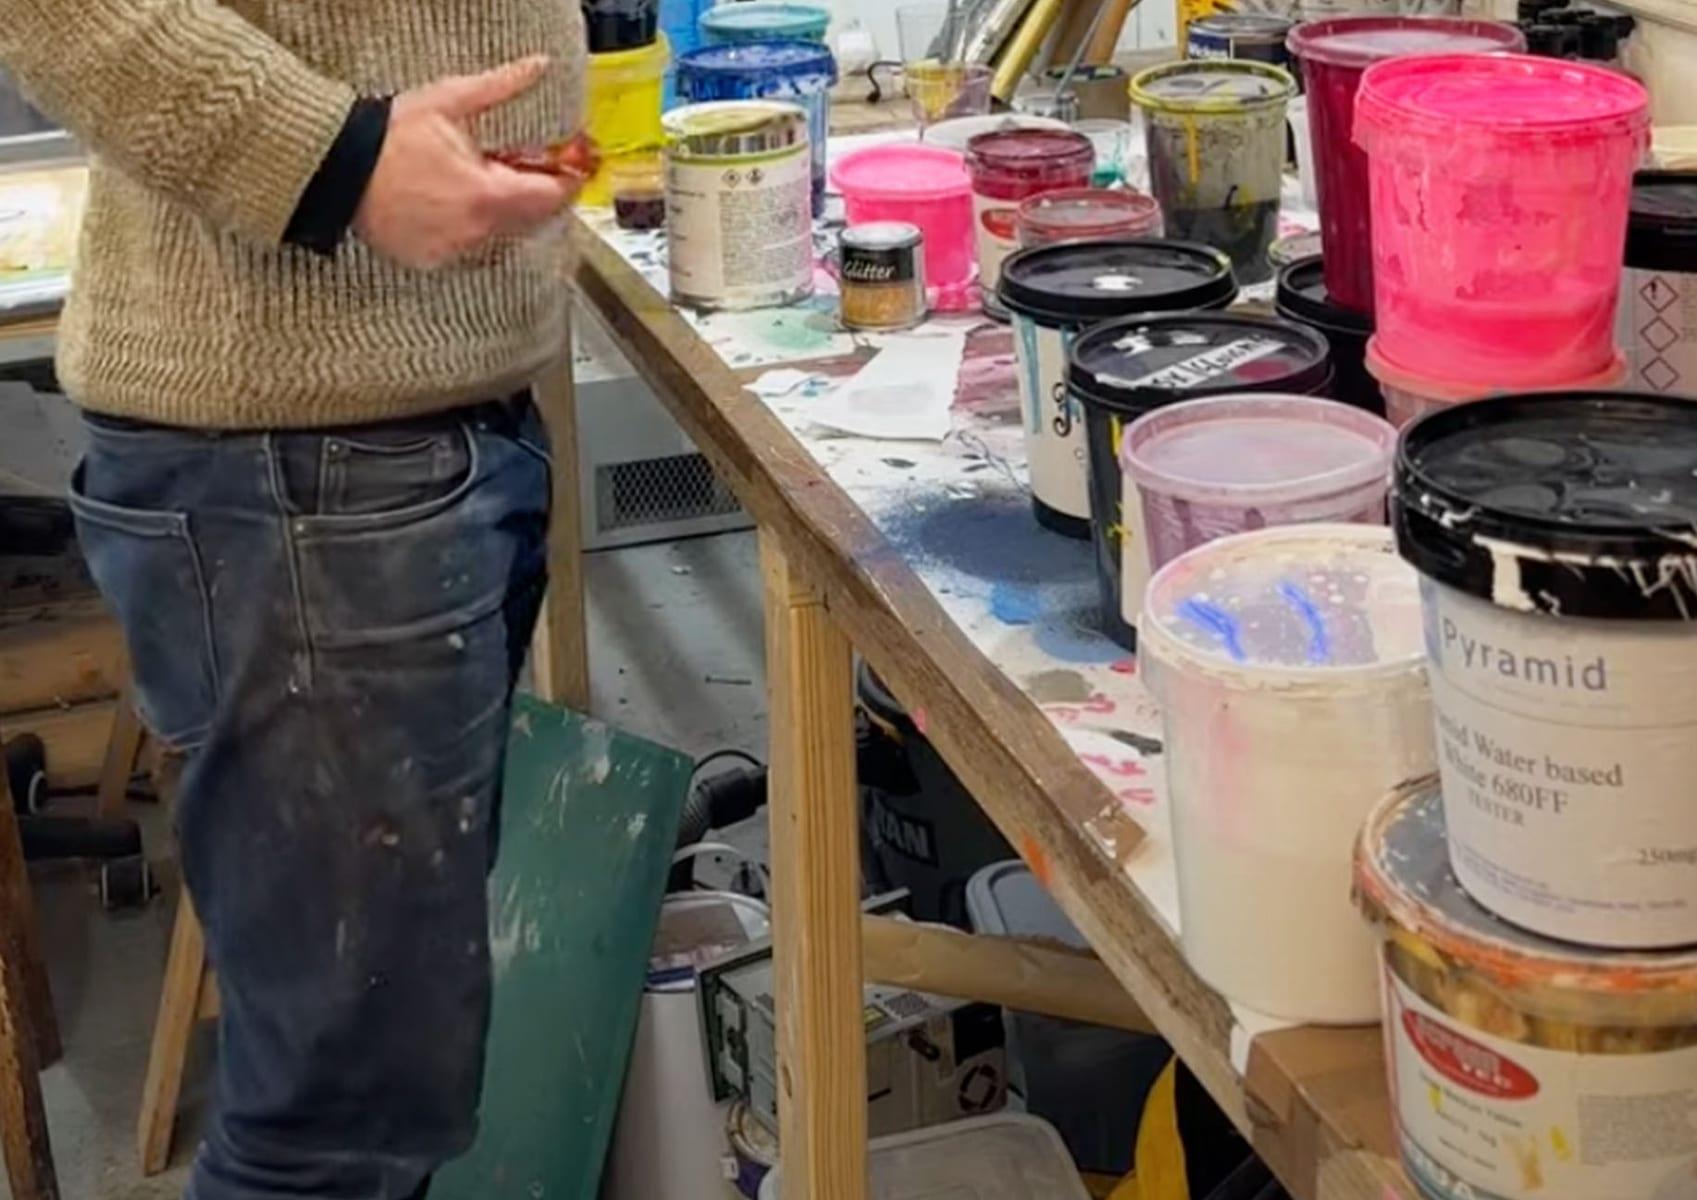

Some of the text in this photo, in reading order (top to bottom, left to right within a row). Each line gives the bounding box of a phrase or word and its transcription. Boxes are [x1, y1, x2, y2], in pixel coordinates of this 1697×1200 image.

[843, 260, 896, 281] Glitter
[1443, 617, 1608, 691] Pyramid
[1473, 729, 1537, 775] Water
[1544, 755, 1625, 788] based
[1491, 774, 1570, 814] 680FF
